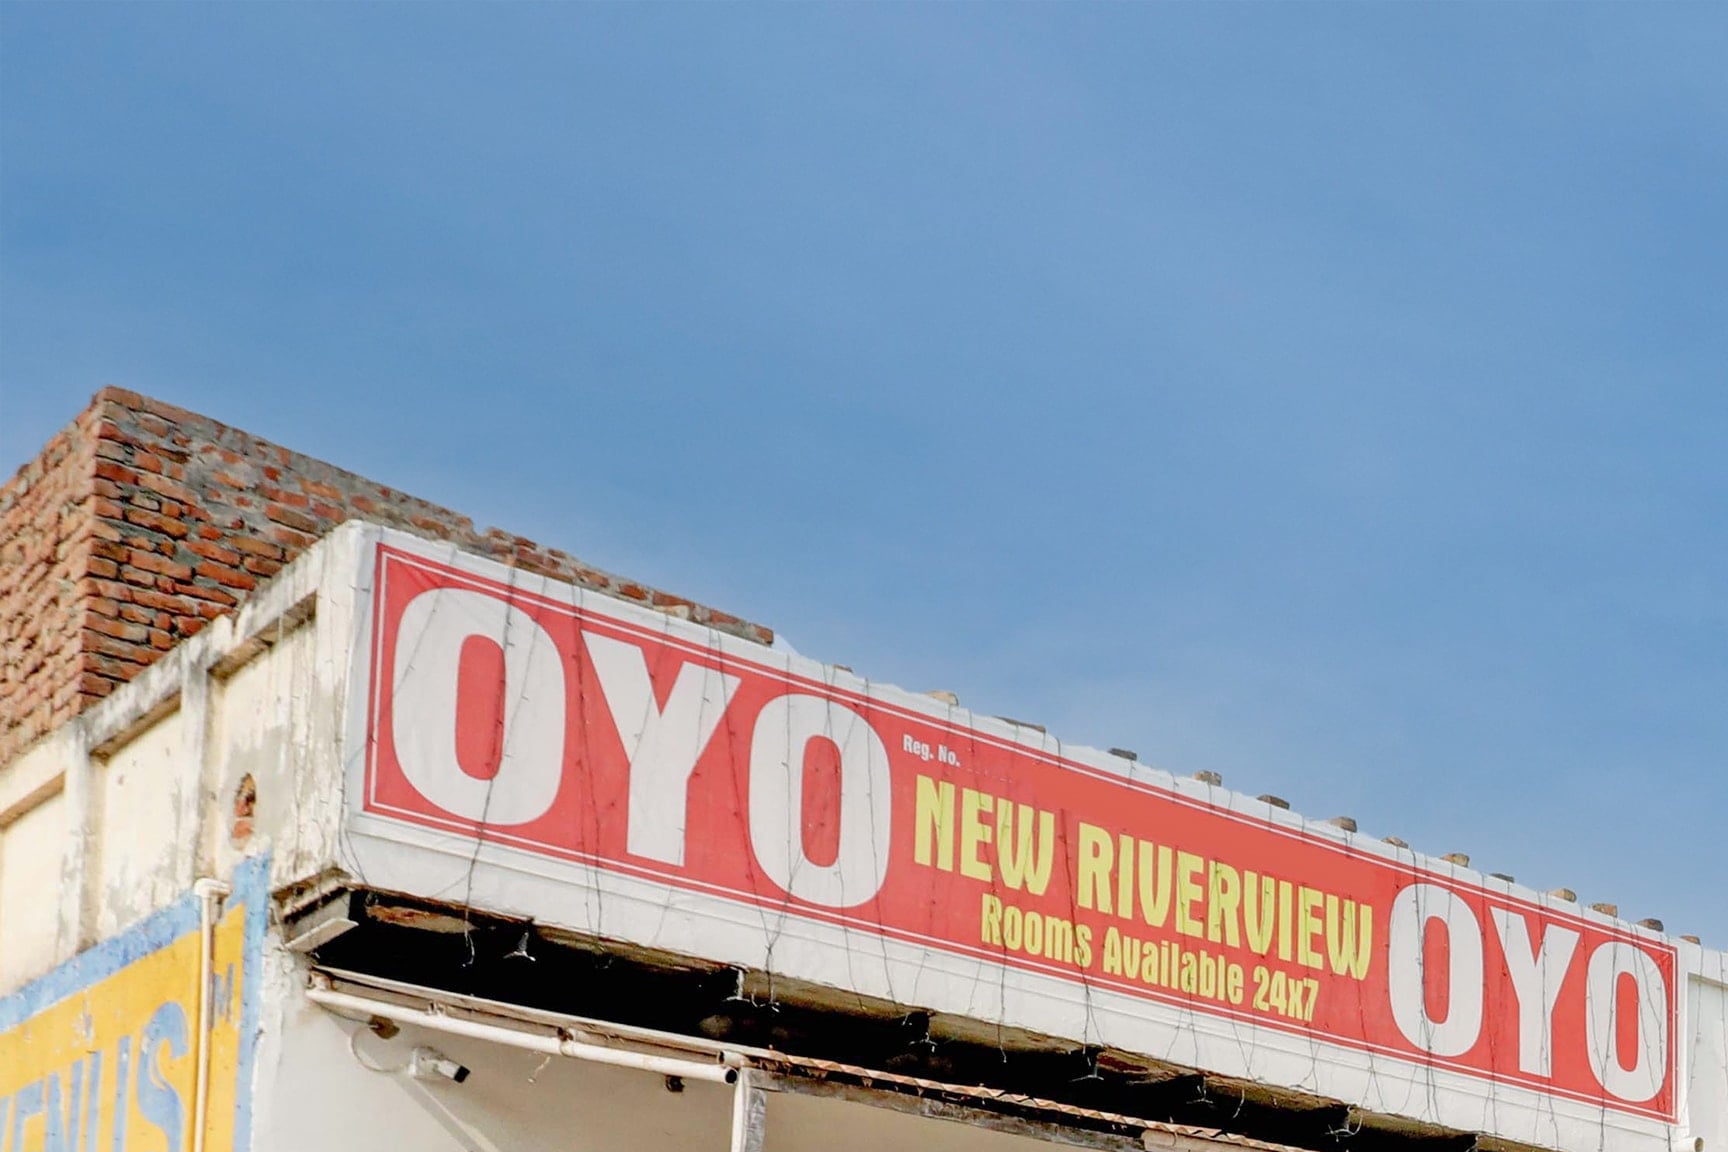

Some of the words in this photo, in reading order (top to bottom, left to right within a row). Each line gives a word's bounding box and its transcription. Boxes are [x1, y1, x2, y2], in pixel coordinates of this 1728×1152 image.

[392, 587, 892, 908] OYO
[903, 734, 934, 761] Reg.
[938, 744, 961, 767] No.
[914, 774, 1055, 896] NEW
[1077, 821, 1373, 981] RIVERVIEW
[981, 893, 1092, 968] Rooms
[1103, 926, 1244, 1004] Available
[1253, 965, 1319, 1021] 24x7
[1388, 883, 1668, 1102] OYO
